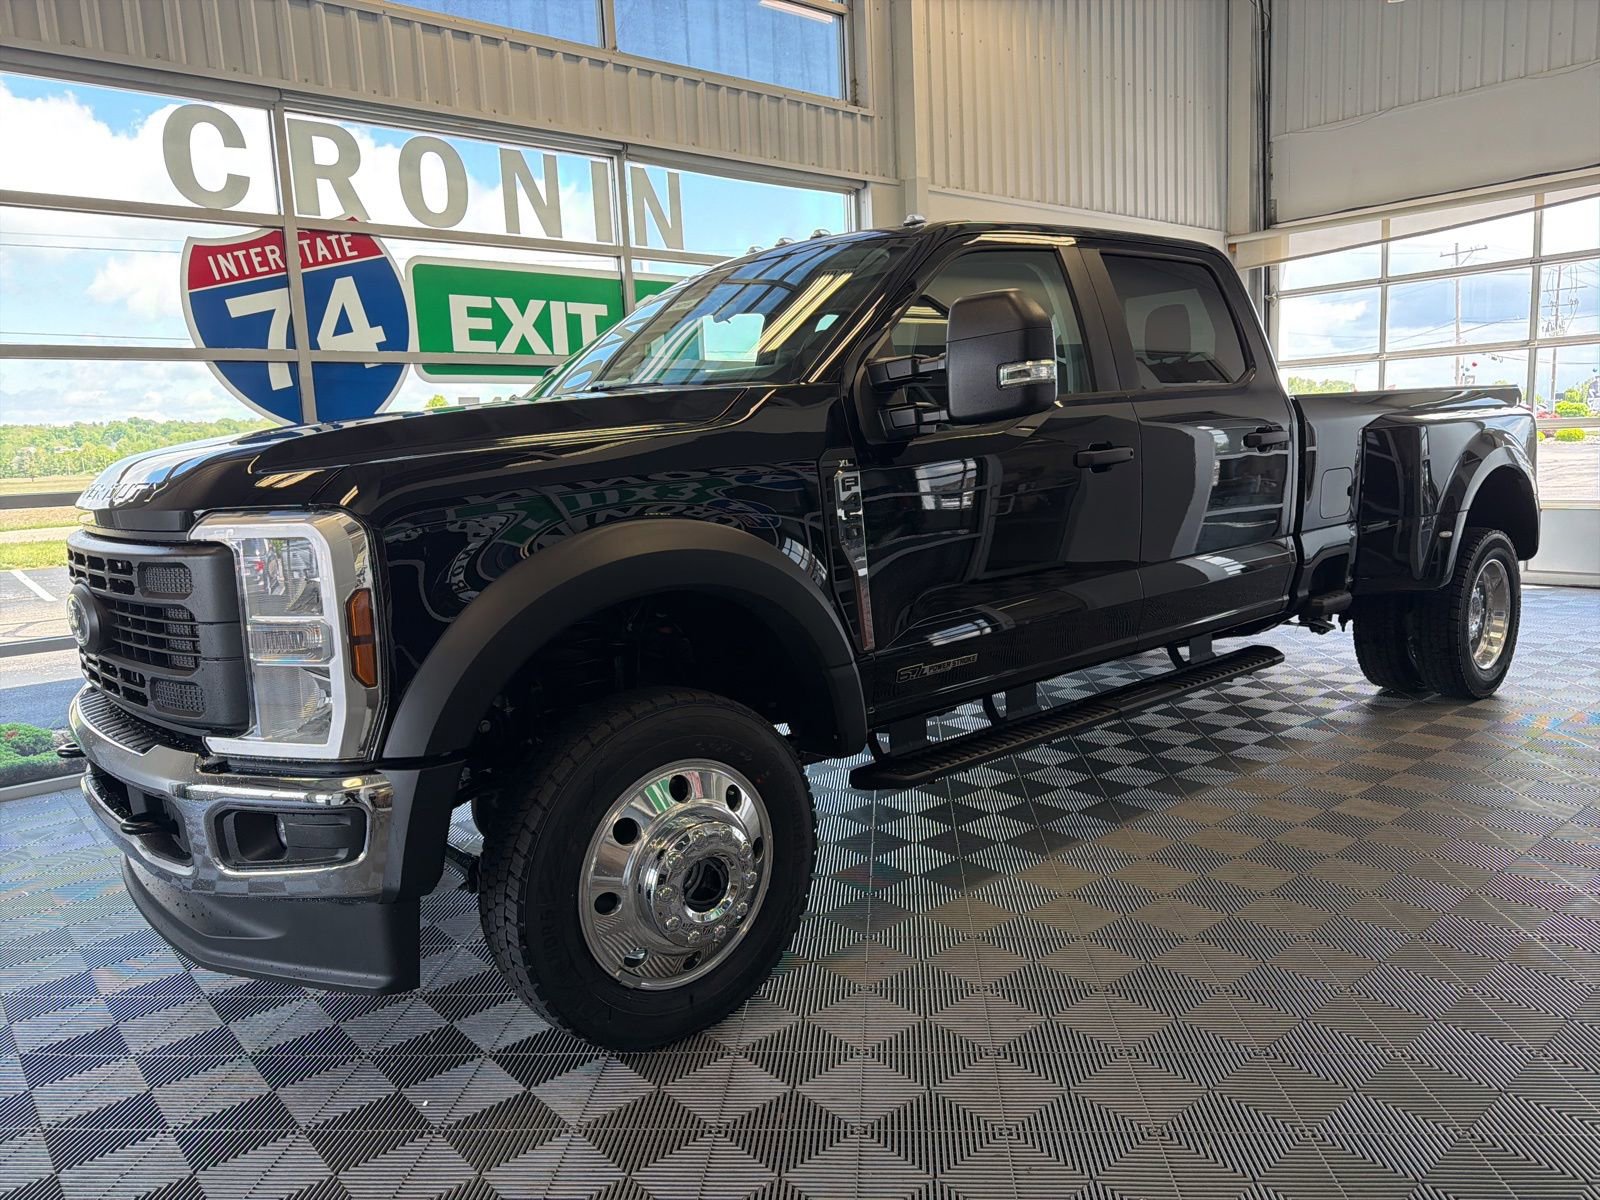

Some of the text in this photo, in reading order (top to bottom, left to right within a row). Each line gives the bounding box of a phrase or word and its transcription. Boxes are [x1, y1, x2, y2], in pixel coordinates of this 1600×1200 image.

[162, 103, 684, 250] CRONIN
[207, 233, 358, 281] INTERTATE
[225, 276, 386, 391] 74
[449, 294, 609, 356] EXIT
[928, 662, 951, 673] POWER
[951, 656, 976, 667] STROKE
